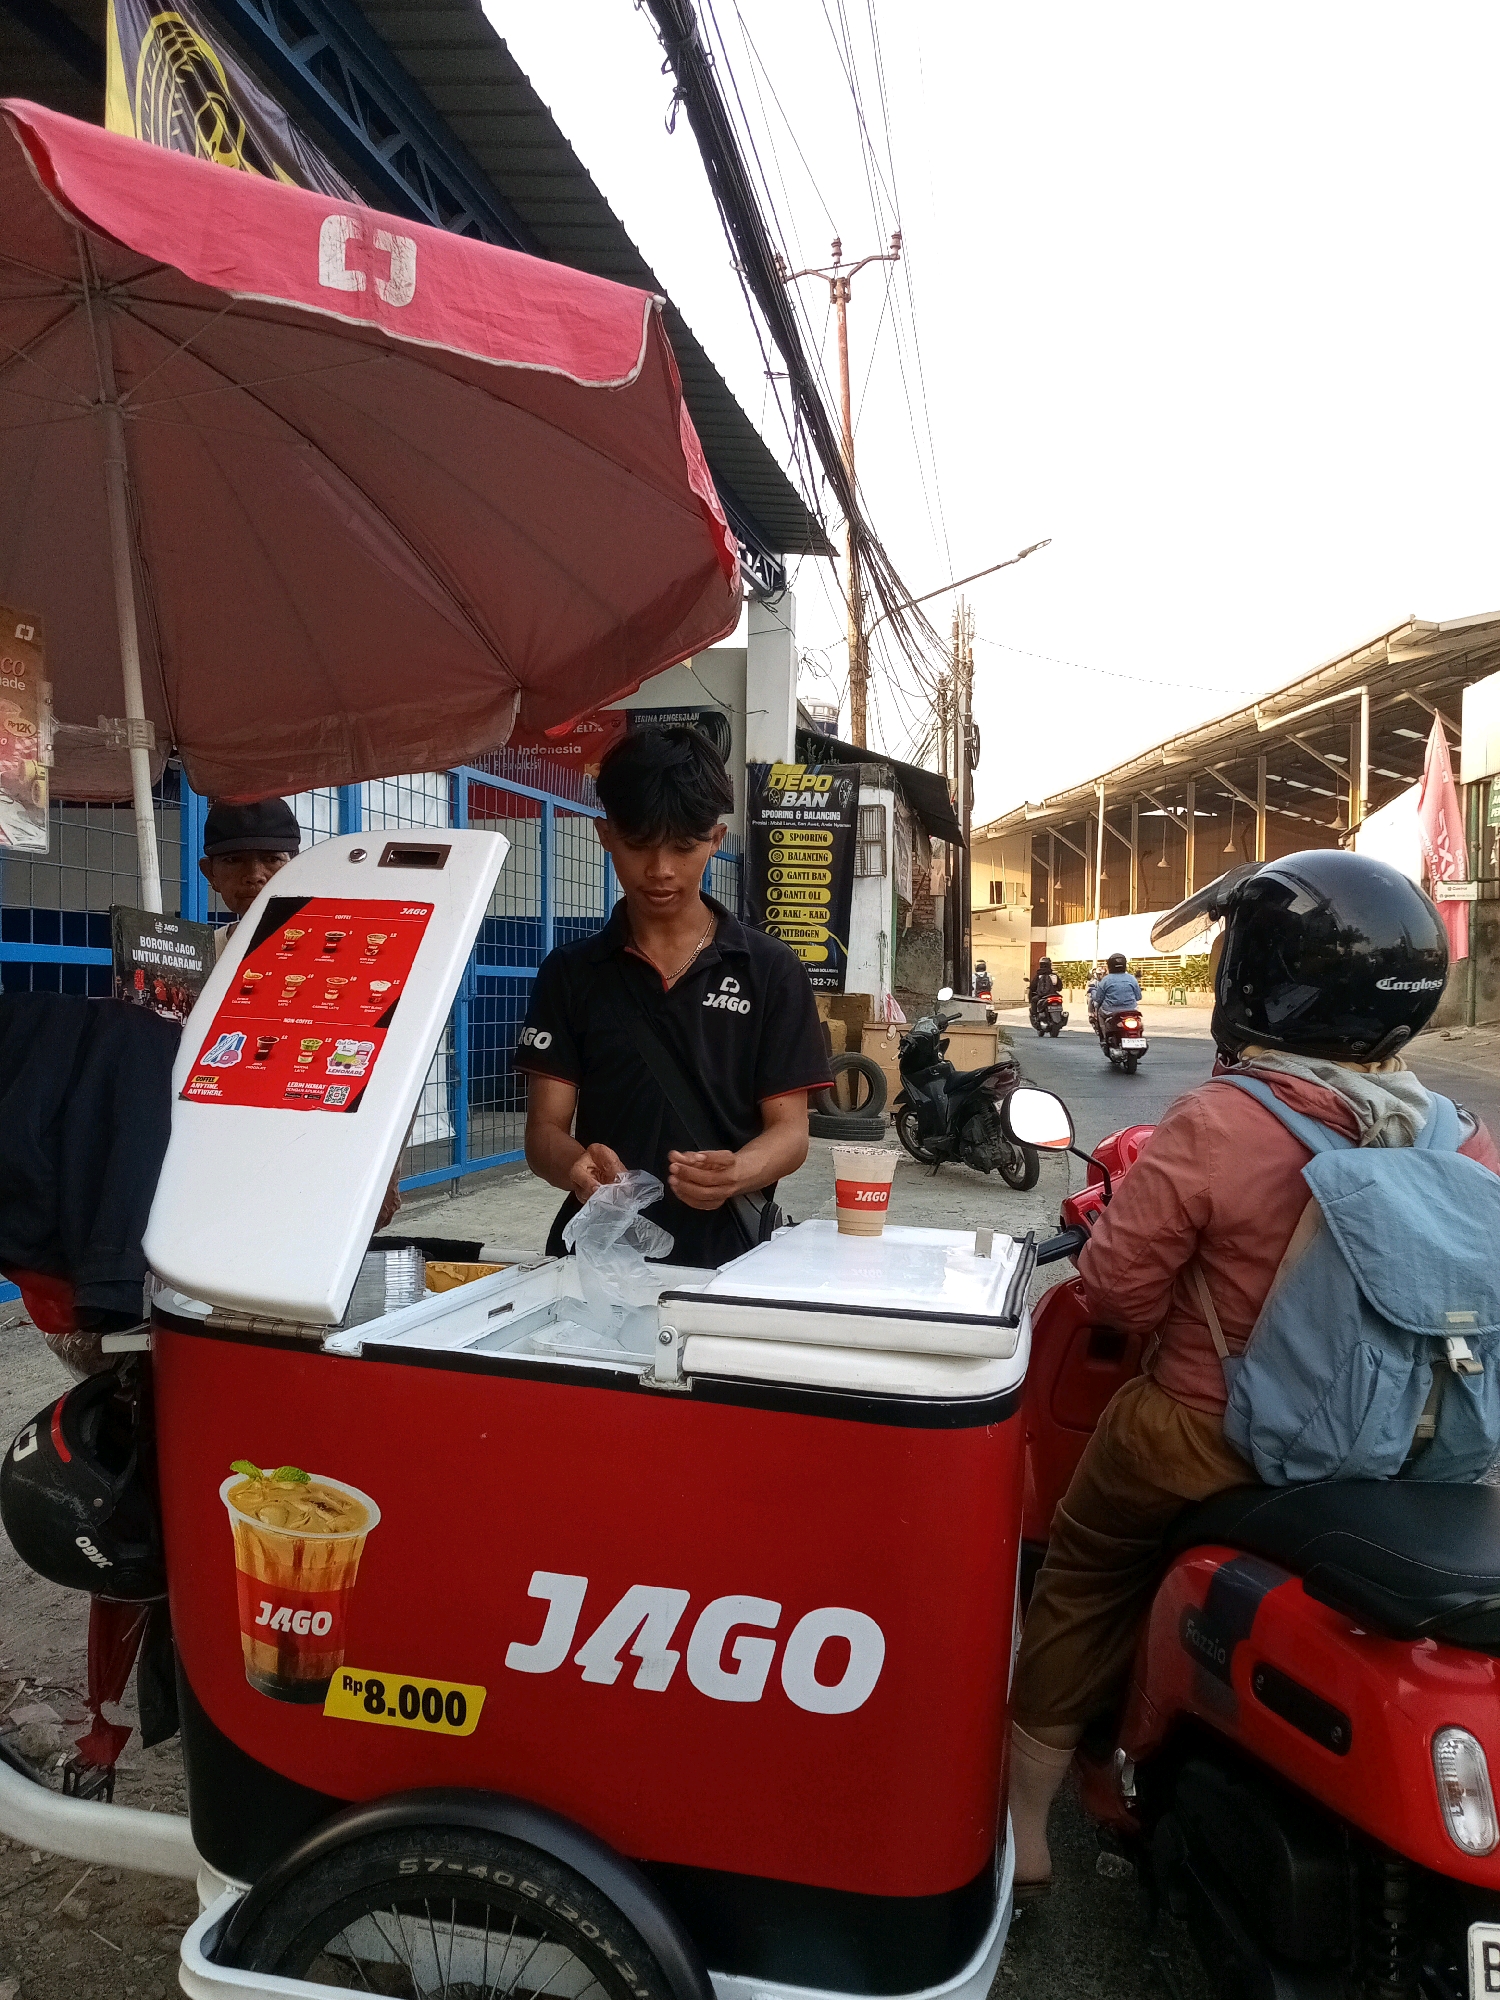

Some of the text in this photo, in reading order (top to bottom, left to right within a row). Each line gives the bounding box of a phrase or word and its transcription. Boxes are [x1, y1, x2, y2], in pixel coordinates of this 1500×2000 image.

[0, 676, 26, 691] ade
[573, 723, 604, 733] ELIX
[518, 743, 582, 755] Indonesia
[769, 773, 833, 791] DEPO
[781, 792, 829, 807] BAN
[762, 810, 840, 820] SPOORING & BALANCING
[790, 833, 828, 843] SPOORING
[788, 852, 828, 862] BALANCING
[787, 871, 827, 881] GANTI BAN
[784, 890, 821, 900] GANTI OLI
[400, 908, 428, 916] JAGO
[783, 909, 801, 918] KAKI
[809, 910, 827, 919] KAKI
[782, 928, 820, 938] NITROGEN
[140, 935, 196, 956] BORONG JAGO
[132, 949, 202, 971] UNTUK ACARAMU!
[1375, 976, 1444, 993] Cargloss
[702, 993, 751, 1015] JAGO
[855, 1190, 887, 1202] JAGO
[75, 1536, 113, 1569] JAGO
[255, 1600, 332, 1636] JAGO
[505, 1570, 886, 1715] JAGO
